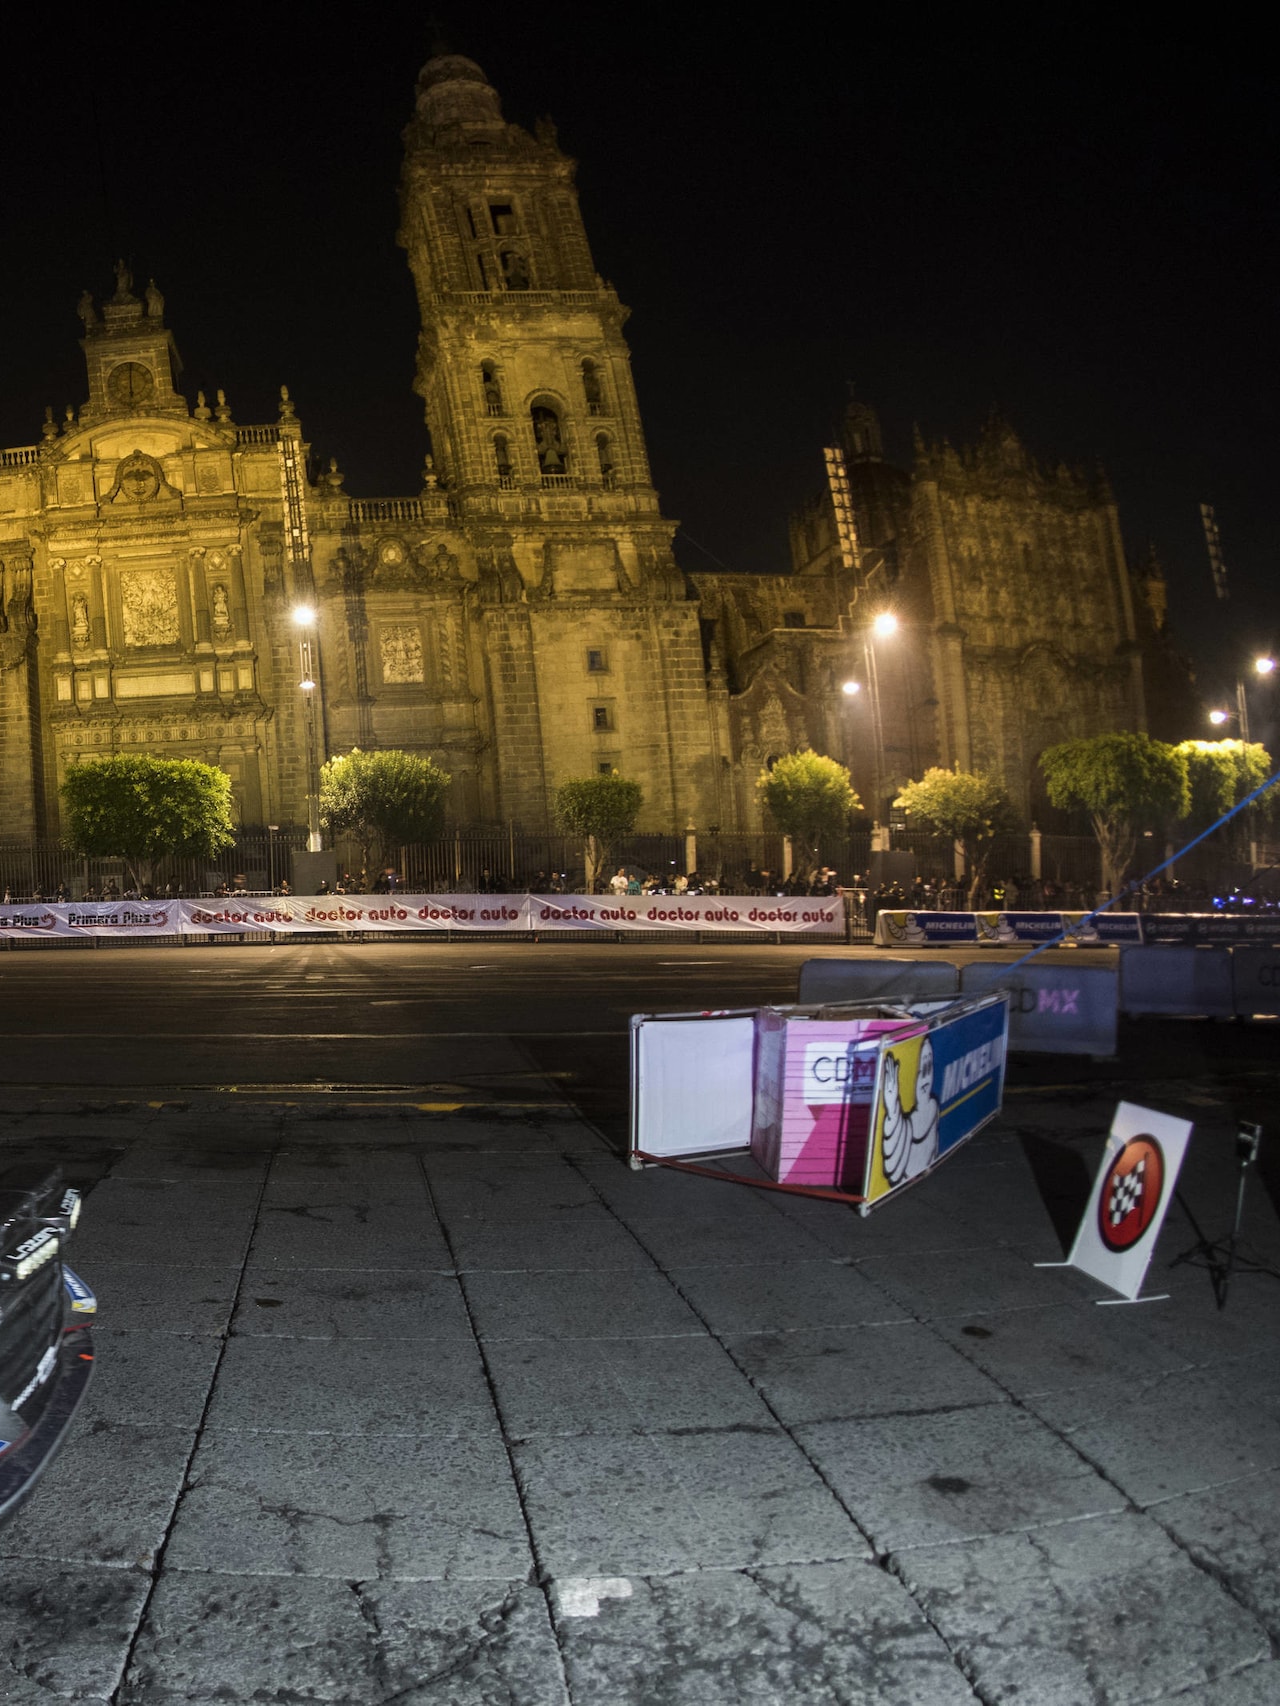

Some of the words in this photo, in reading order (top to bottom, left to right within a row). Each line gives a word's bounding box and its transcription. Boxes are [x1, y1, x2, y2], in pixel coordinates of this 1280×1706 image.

[68, 913, 118, 926] Primera
[123, 912, 150, 925] Plus
[305, 907, 363, 921] doctor
[368, 908, 408, 921] auto
[418, 905, 475, 921] doctor
[480, 906, 519, 921] auto
[540, 906, 595, 921] doctor
[600, 907, 637, 921] auto
[647, 907, 700, 921] doctor
[704, 907, 739, 922] auto
[748, 907, 799, 922] doctor
[802, 909, 834, 923] auto
[12, 915, 39, 927] Plus
[925, 921, 976, 930] MICHELIN
[1015, 921, 1061, 930] MICHELIN
